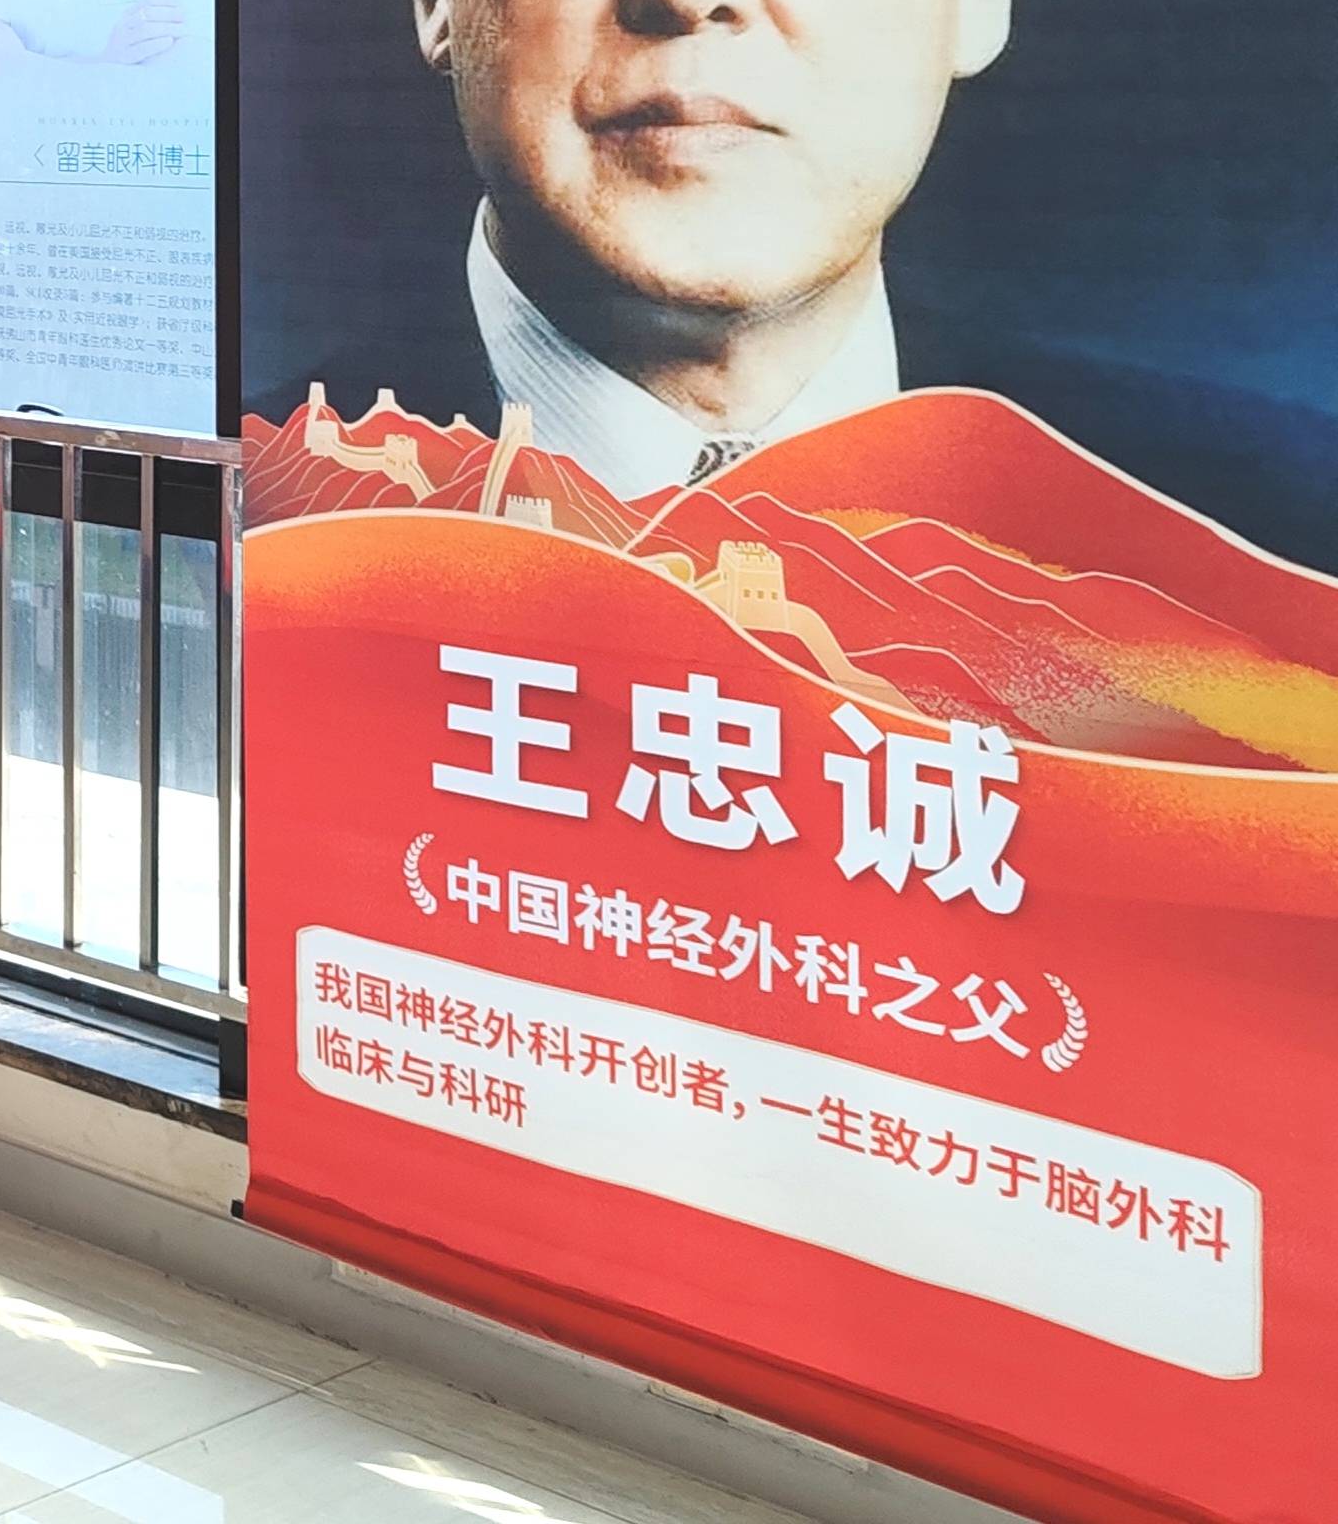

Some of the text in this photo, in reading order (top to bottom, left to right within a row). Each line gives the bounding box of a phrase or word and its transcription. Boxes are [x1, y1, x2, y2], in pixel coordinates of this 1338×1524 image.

[431, 643, 1027, 916] 王忠诚
[445, 857, 1033, 1061] 中国神经外科之父
[315, 1034, 529, 1129] 临床与科研
